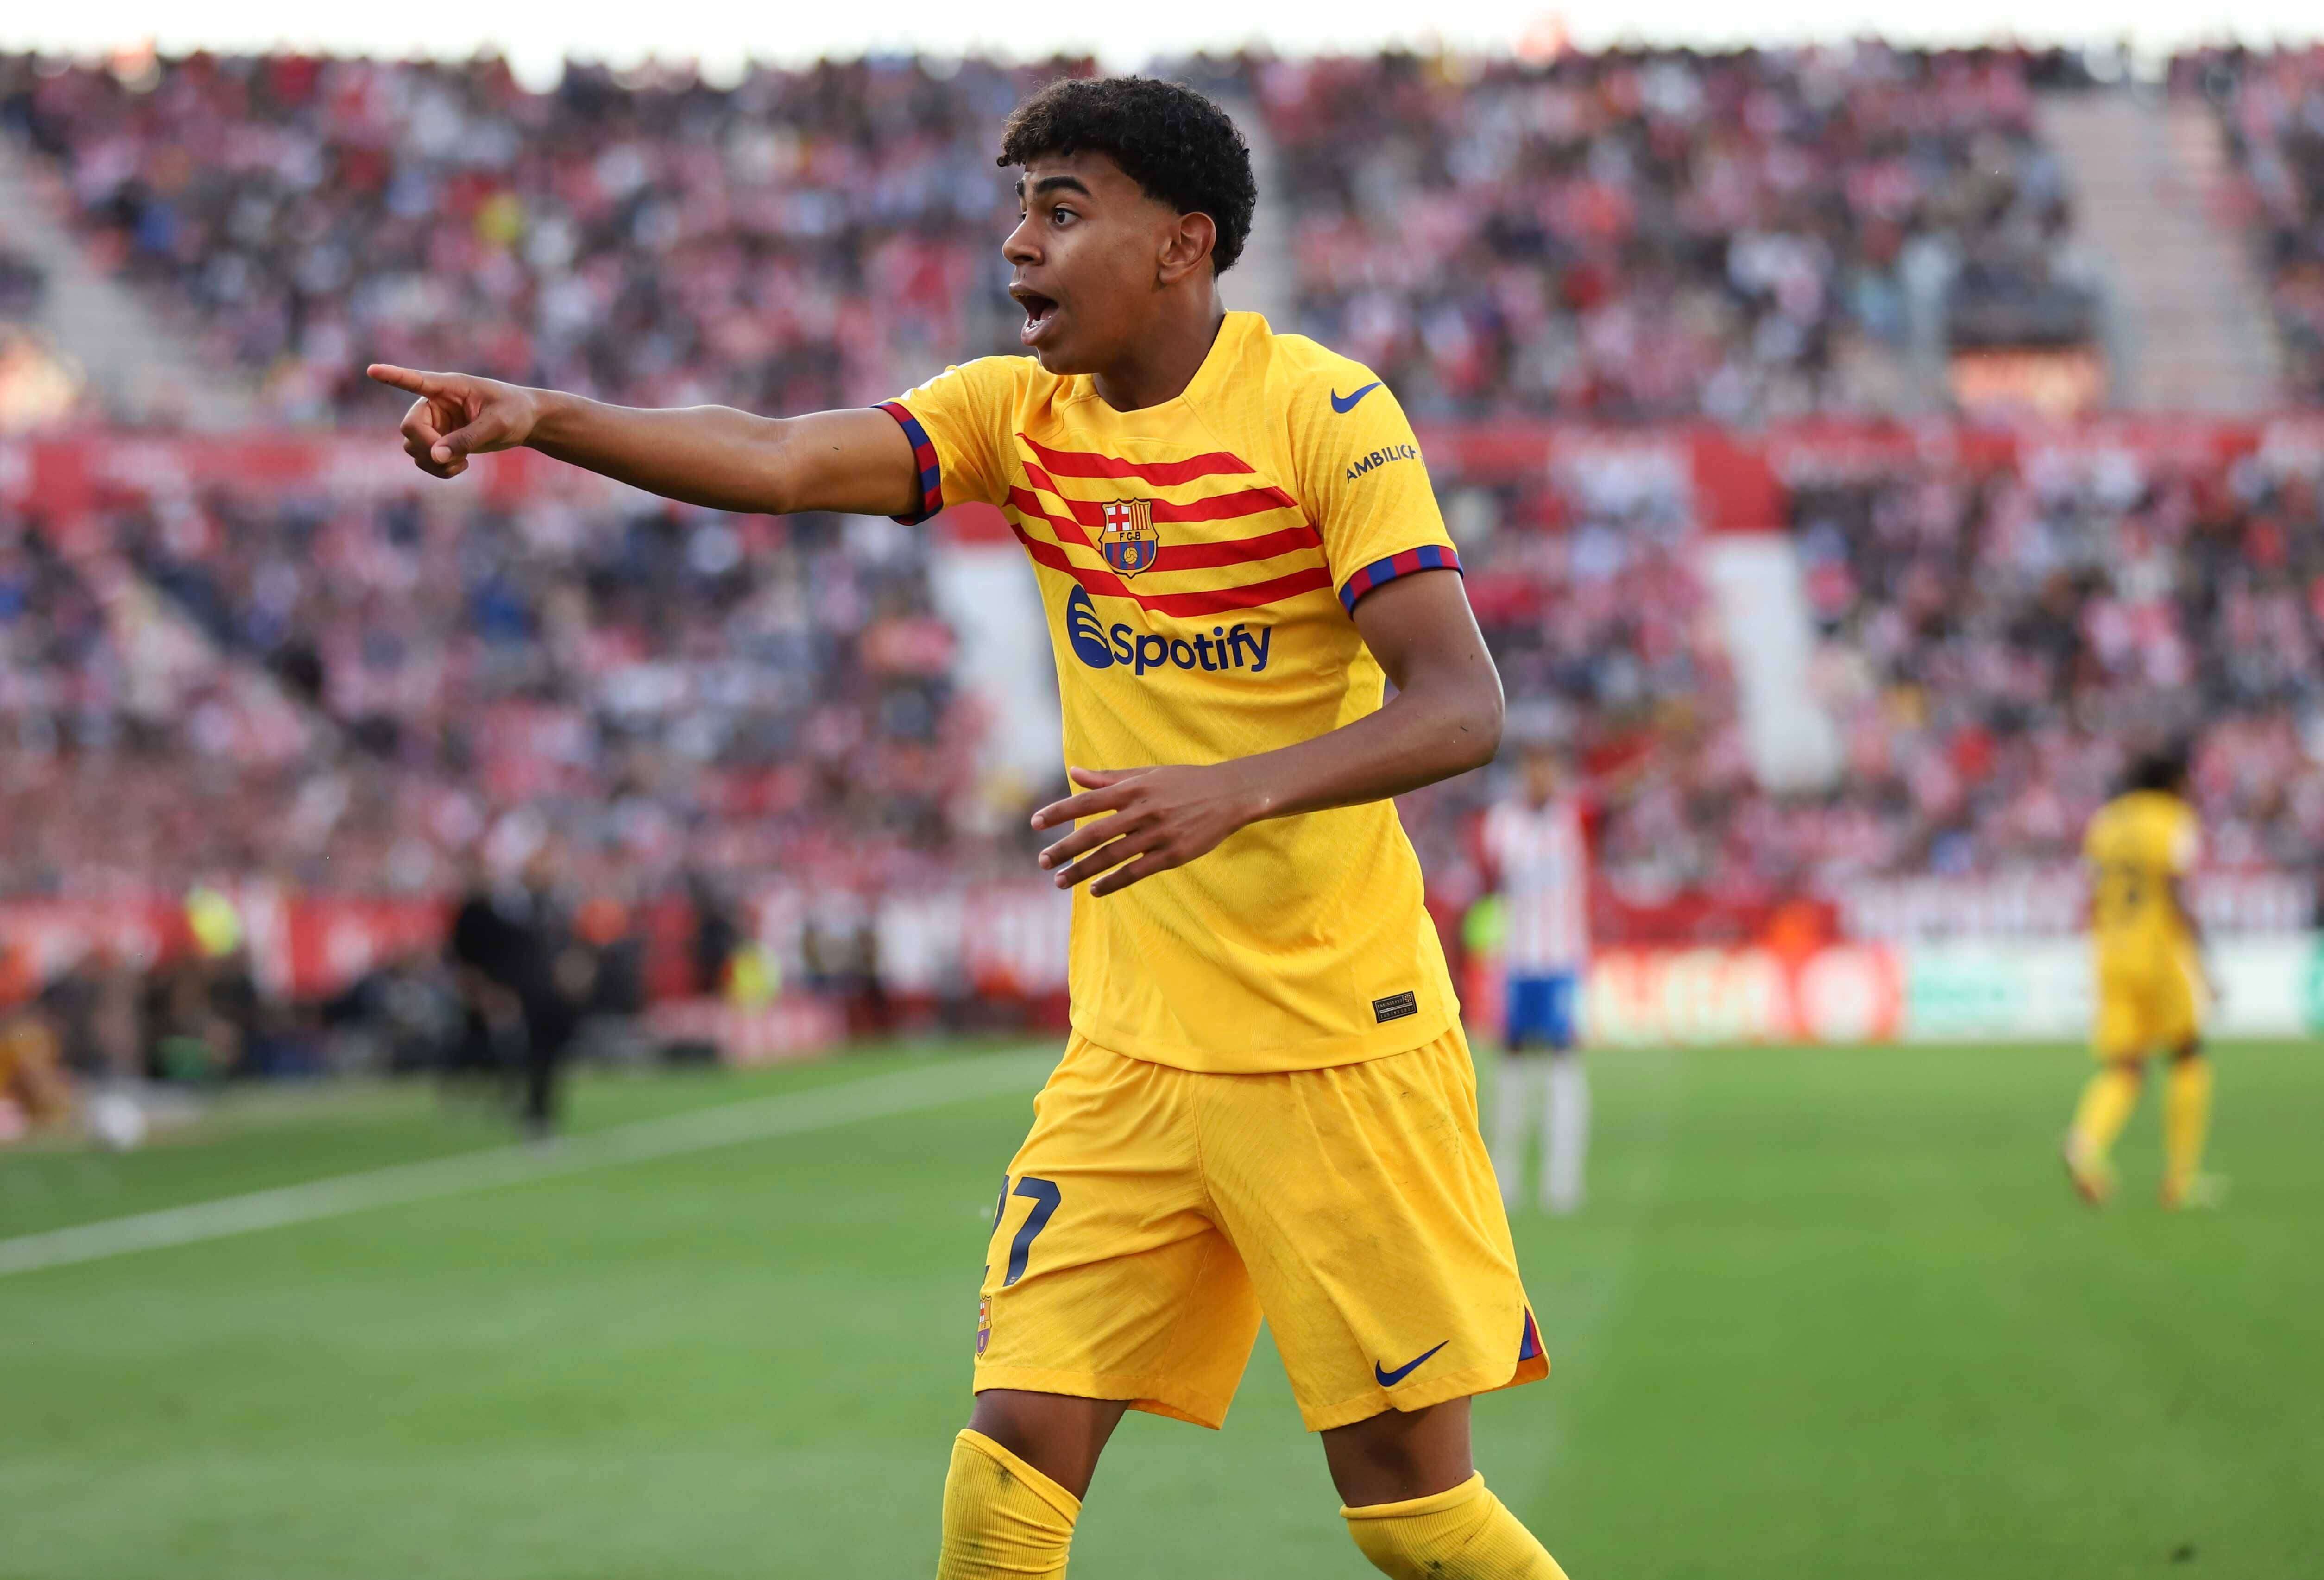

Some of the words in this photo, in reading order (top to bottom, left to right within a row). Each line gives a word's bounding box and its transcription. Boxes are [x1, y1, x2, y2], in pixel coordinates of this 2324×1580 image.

[1119, 531, 1141, 541] FCB
[1110, 623, 1271, 675] Spotify
[983, 1174, 1061, 1287] 7
